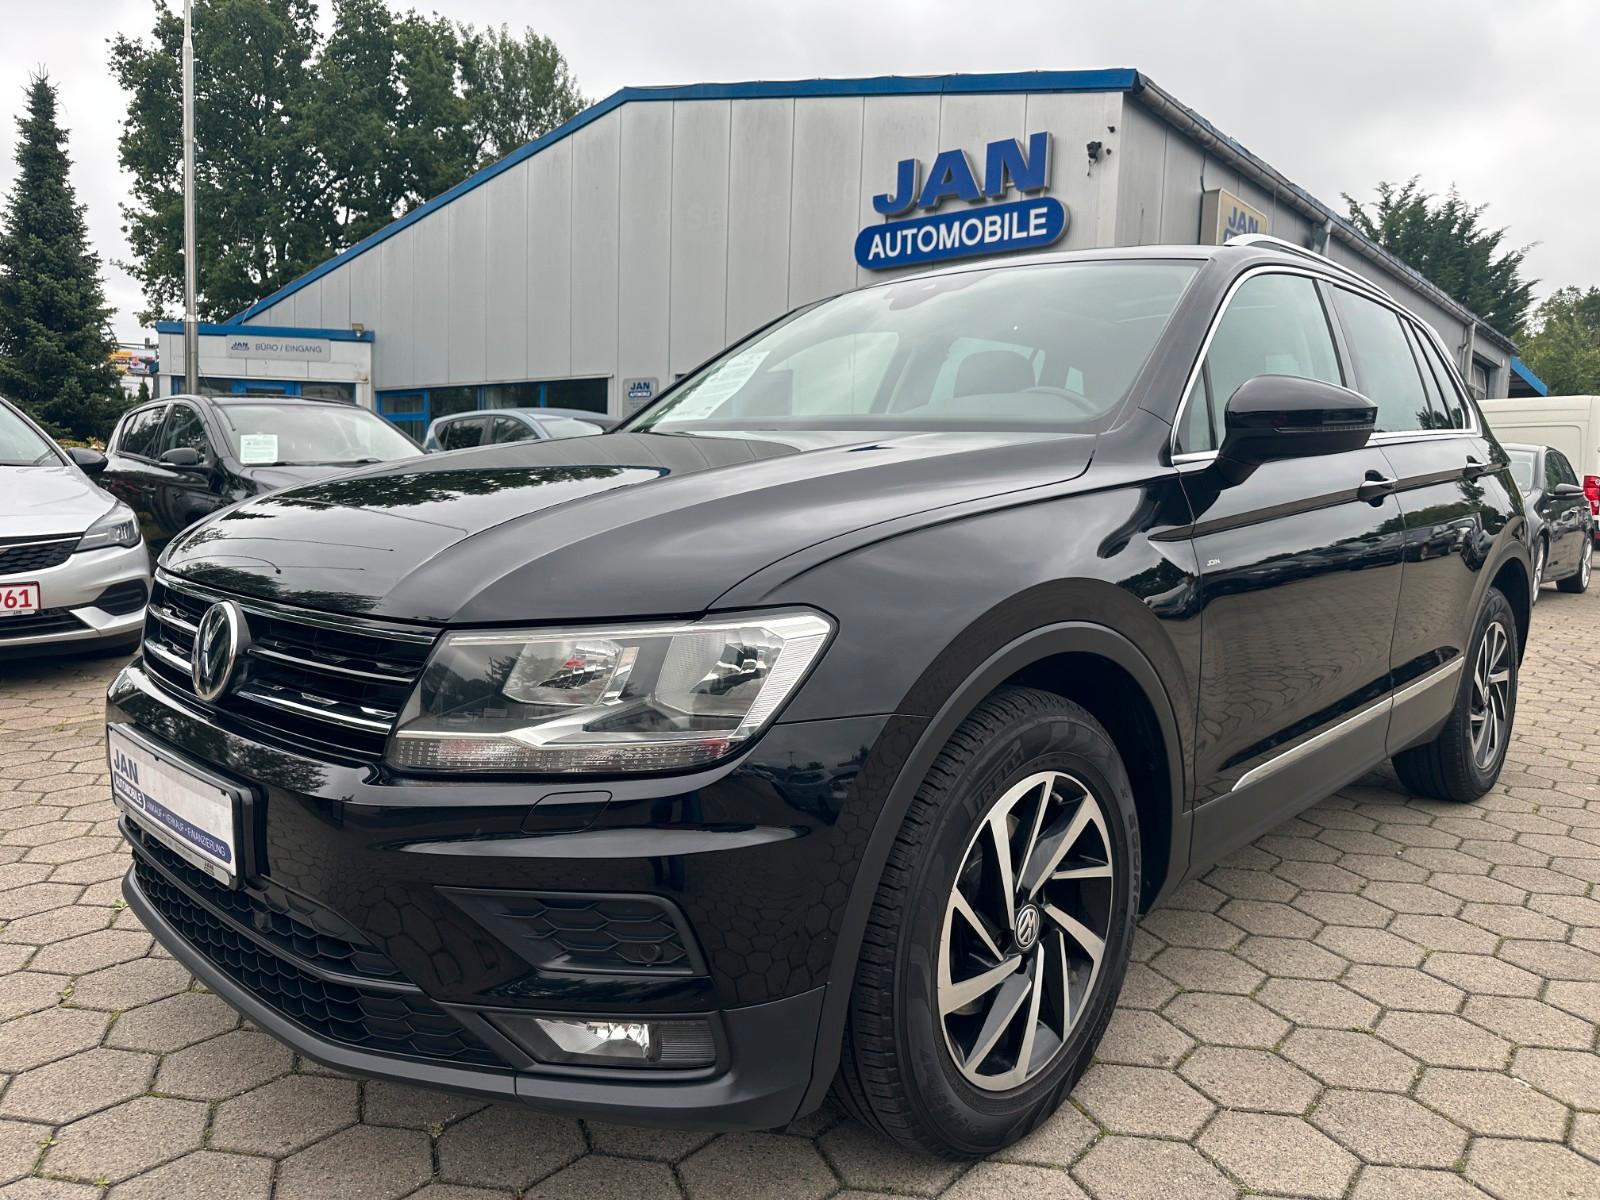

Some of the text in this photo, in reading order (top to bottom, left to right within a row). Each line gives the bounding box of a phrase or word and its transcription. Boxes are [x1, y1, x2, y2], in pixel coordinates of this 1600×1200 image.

[872, 131, 1051, 215] JAN
[867, 206, 1049, 260] AUTOMOBILE
[1228, 206, 1258, 234] JAN
[630, 381, 650, 390] JAN
[0, 589, 32, 609] 61
[113, 748, 139, 785] JAN
